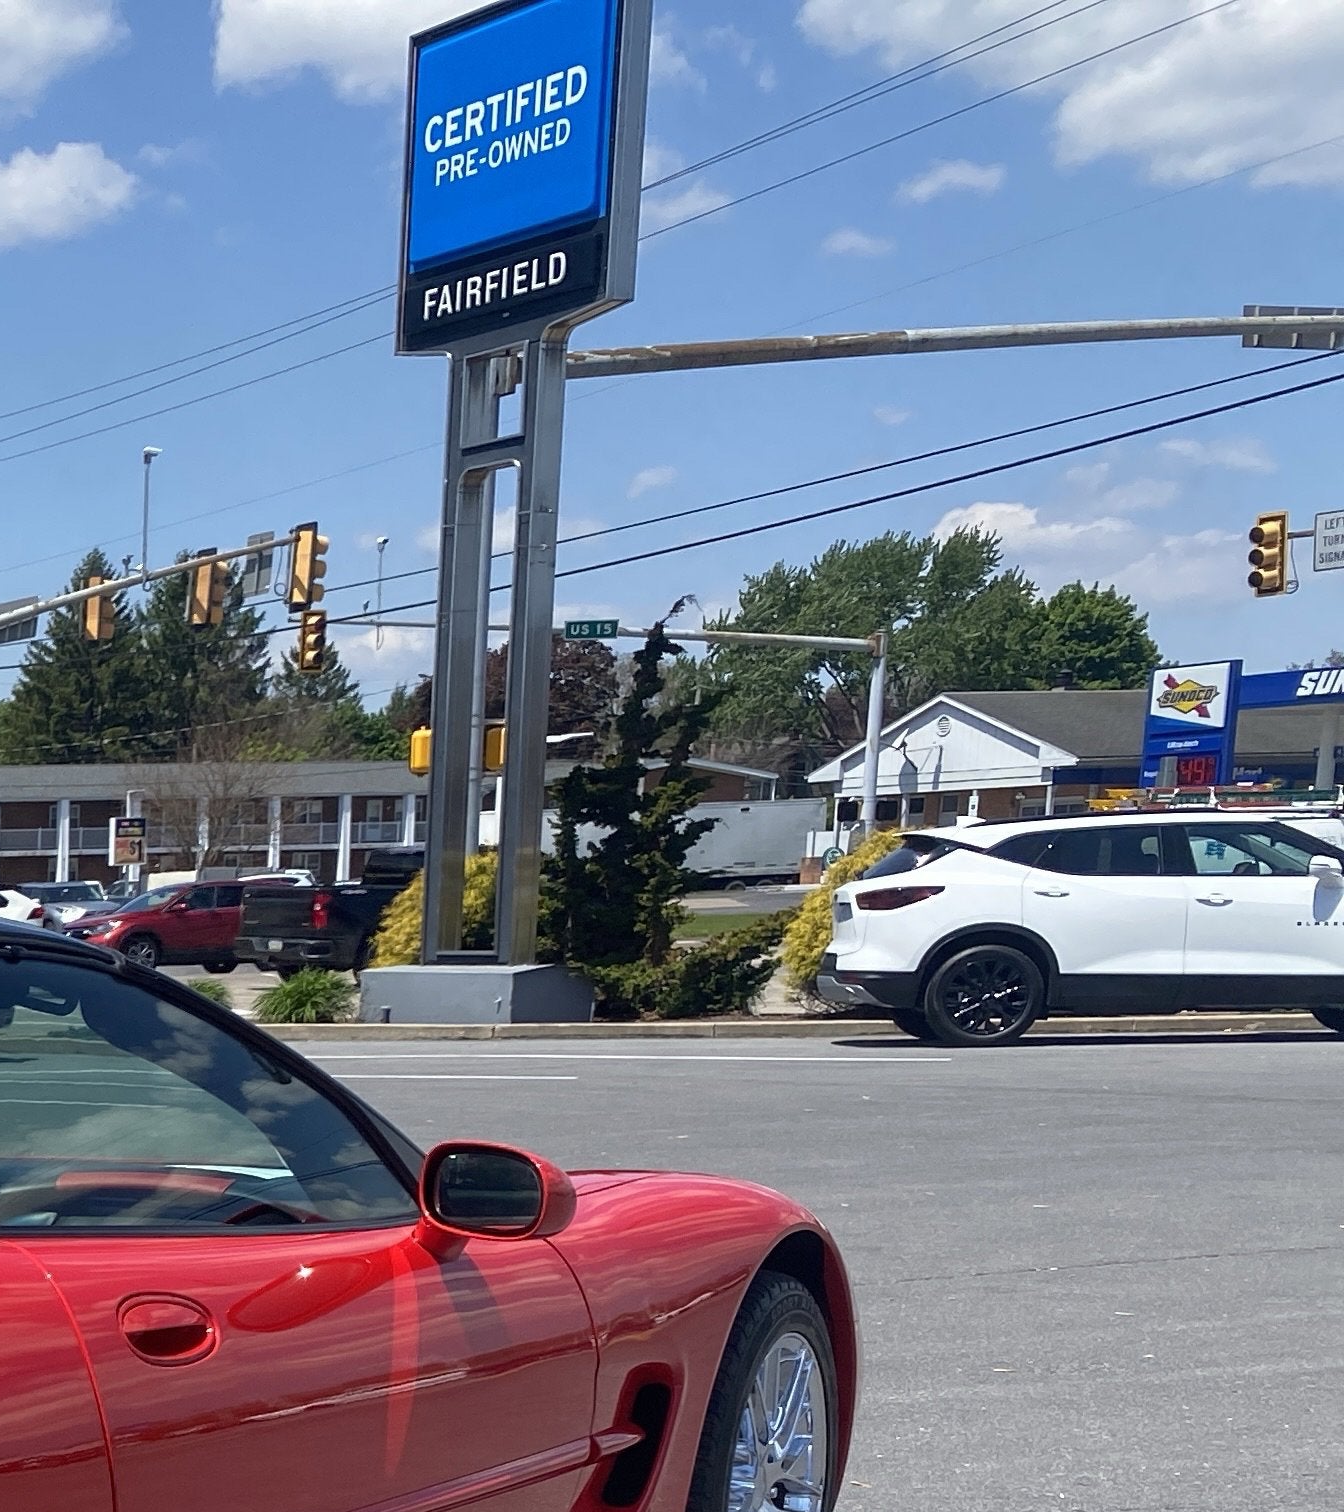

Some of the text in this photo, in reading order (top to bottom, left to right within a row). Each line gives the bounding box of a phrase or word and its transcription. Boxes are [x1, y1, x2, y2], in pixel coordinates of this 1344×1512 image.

[424, 64, 588, 153] CERTIFIED
[435, 118, 571, 187] PRE-OWNED
[423, 252, 567, 321] FAIRFIELD
[570, 623, 613, 635] US 15
[1162, 688, 1215, 704] SUNOCO
